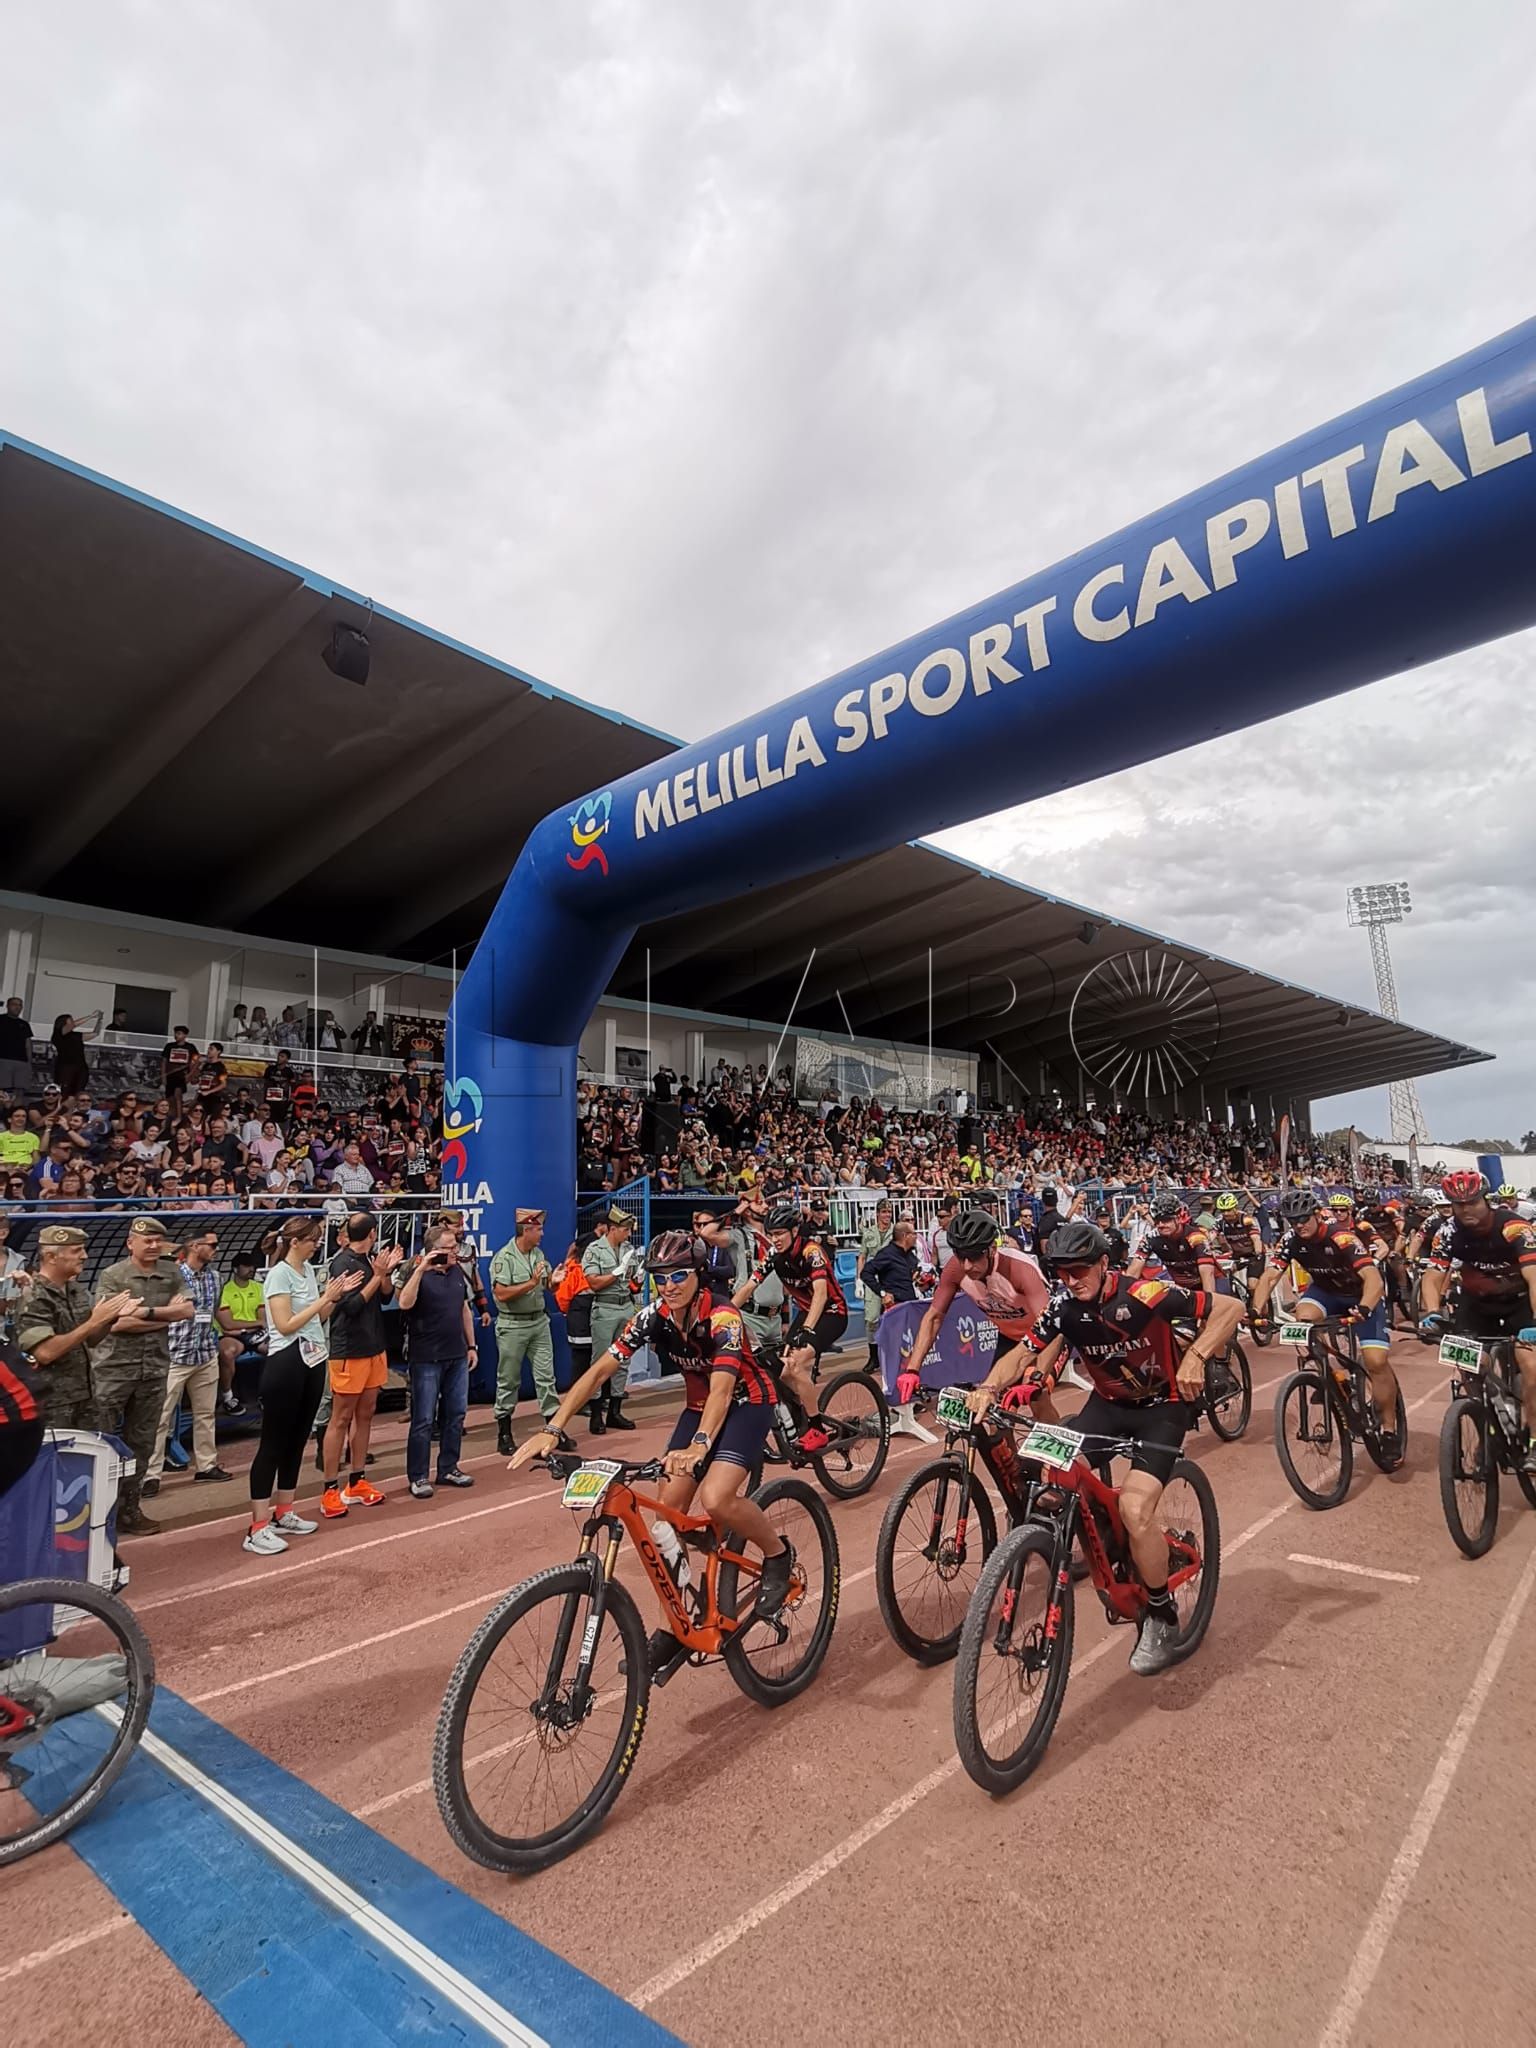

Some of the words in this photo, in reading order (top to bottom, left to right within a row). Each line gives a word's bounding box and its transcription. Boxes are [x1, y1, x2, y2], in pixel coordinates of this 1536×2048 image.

[634, 717, 827, 838] MELILLA
[835, 595, 1059, 753] SPORT
[1072, 386, 1533, 643] CAPITAL
[978, 1329, 999, 1342] SPORT
[1286, 1328, 1308, 1341] 2224
[1083, 1337, 1152, 1356] AFRICANA
[641, 1541, 689, 1637] ORBEA
